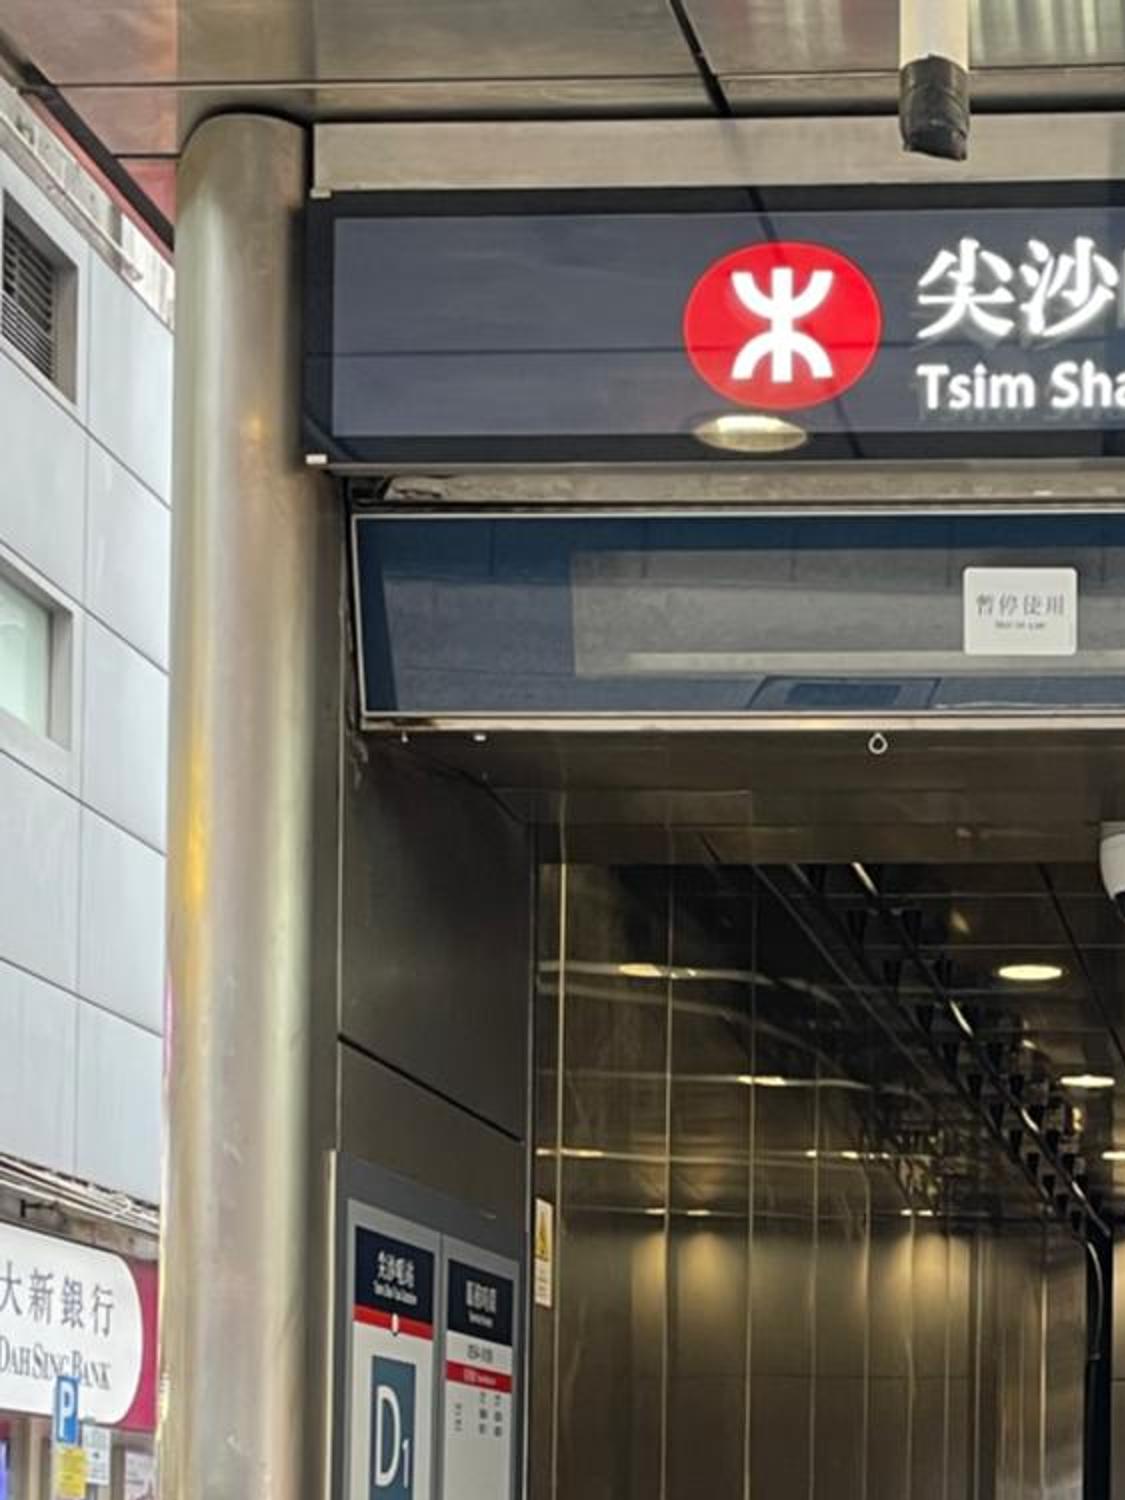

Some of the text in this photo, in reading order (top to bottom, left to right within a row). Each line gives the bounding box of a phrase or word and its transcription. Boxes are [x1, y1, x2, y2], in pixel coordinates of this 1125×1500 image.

[916, 363, 1036, 409] Tsim
[0, 1260, 114, 1337] 大新銀行
[58, 1378, 76, 1442] P
